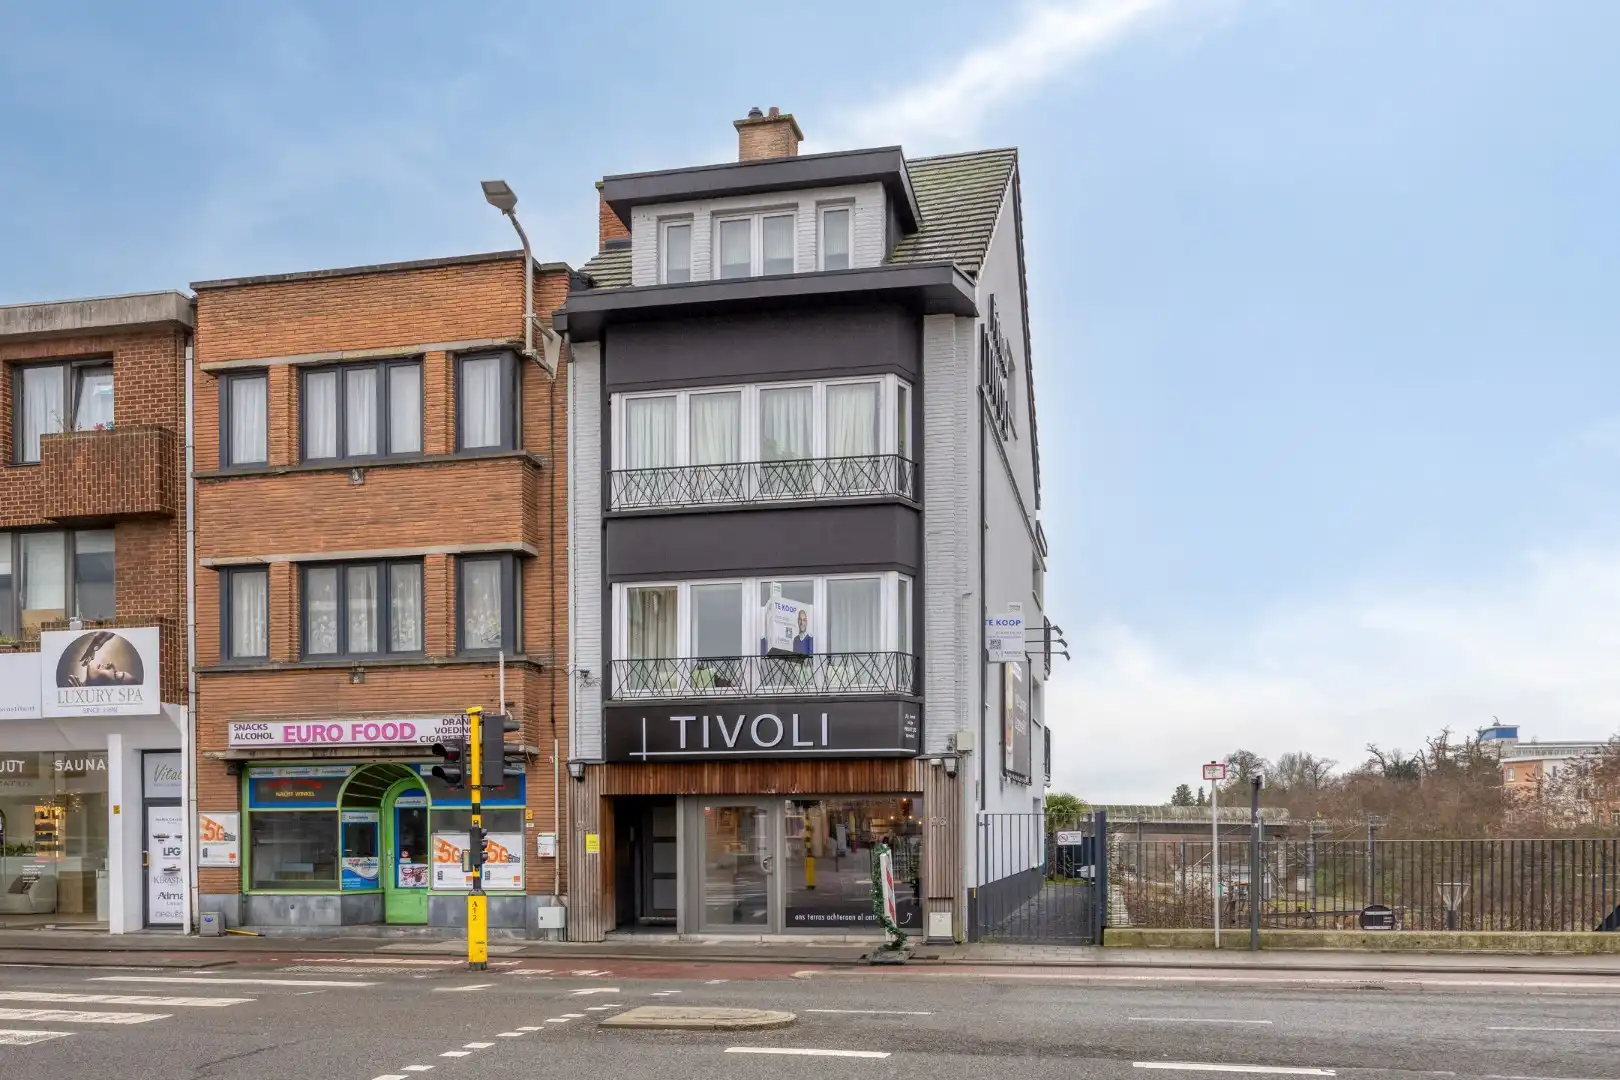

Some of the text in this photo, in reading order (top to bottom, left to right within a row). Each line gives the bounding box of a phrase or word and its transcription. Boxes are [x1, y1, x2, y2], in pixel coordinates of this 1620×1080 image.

[57, 687, 144, 704] LUXURY SPA
[442, 718, 472, 726] DRAN
[233, 723, 268, 731] SNACKS
[669, 713, 828, 749] TIVOLI
[234, 732, 274, 740] ALCOHOL
[283, 722, 416, 743] EURO FOOD
[54, 759, 106, 771] SAUNA
[163, 847, 181, 856] LPG
[807, 913, 825, 921] terras
[826, 912, 856, 921] achteraan
[857, 913, 864, 921] al
